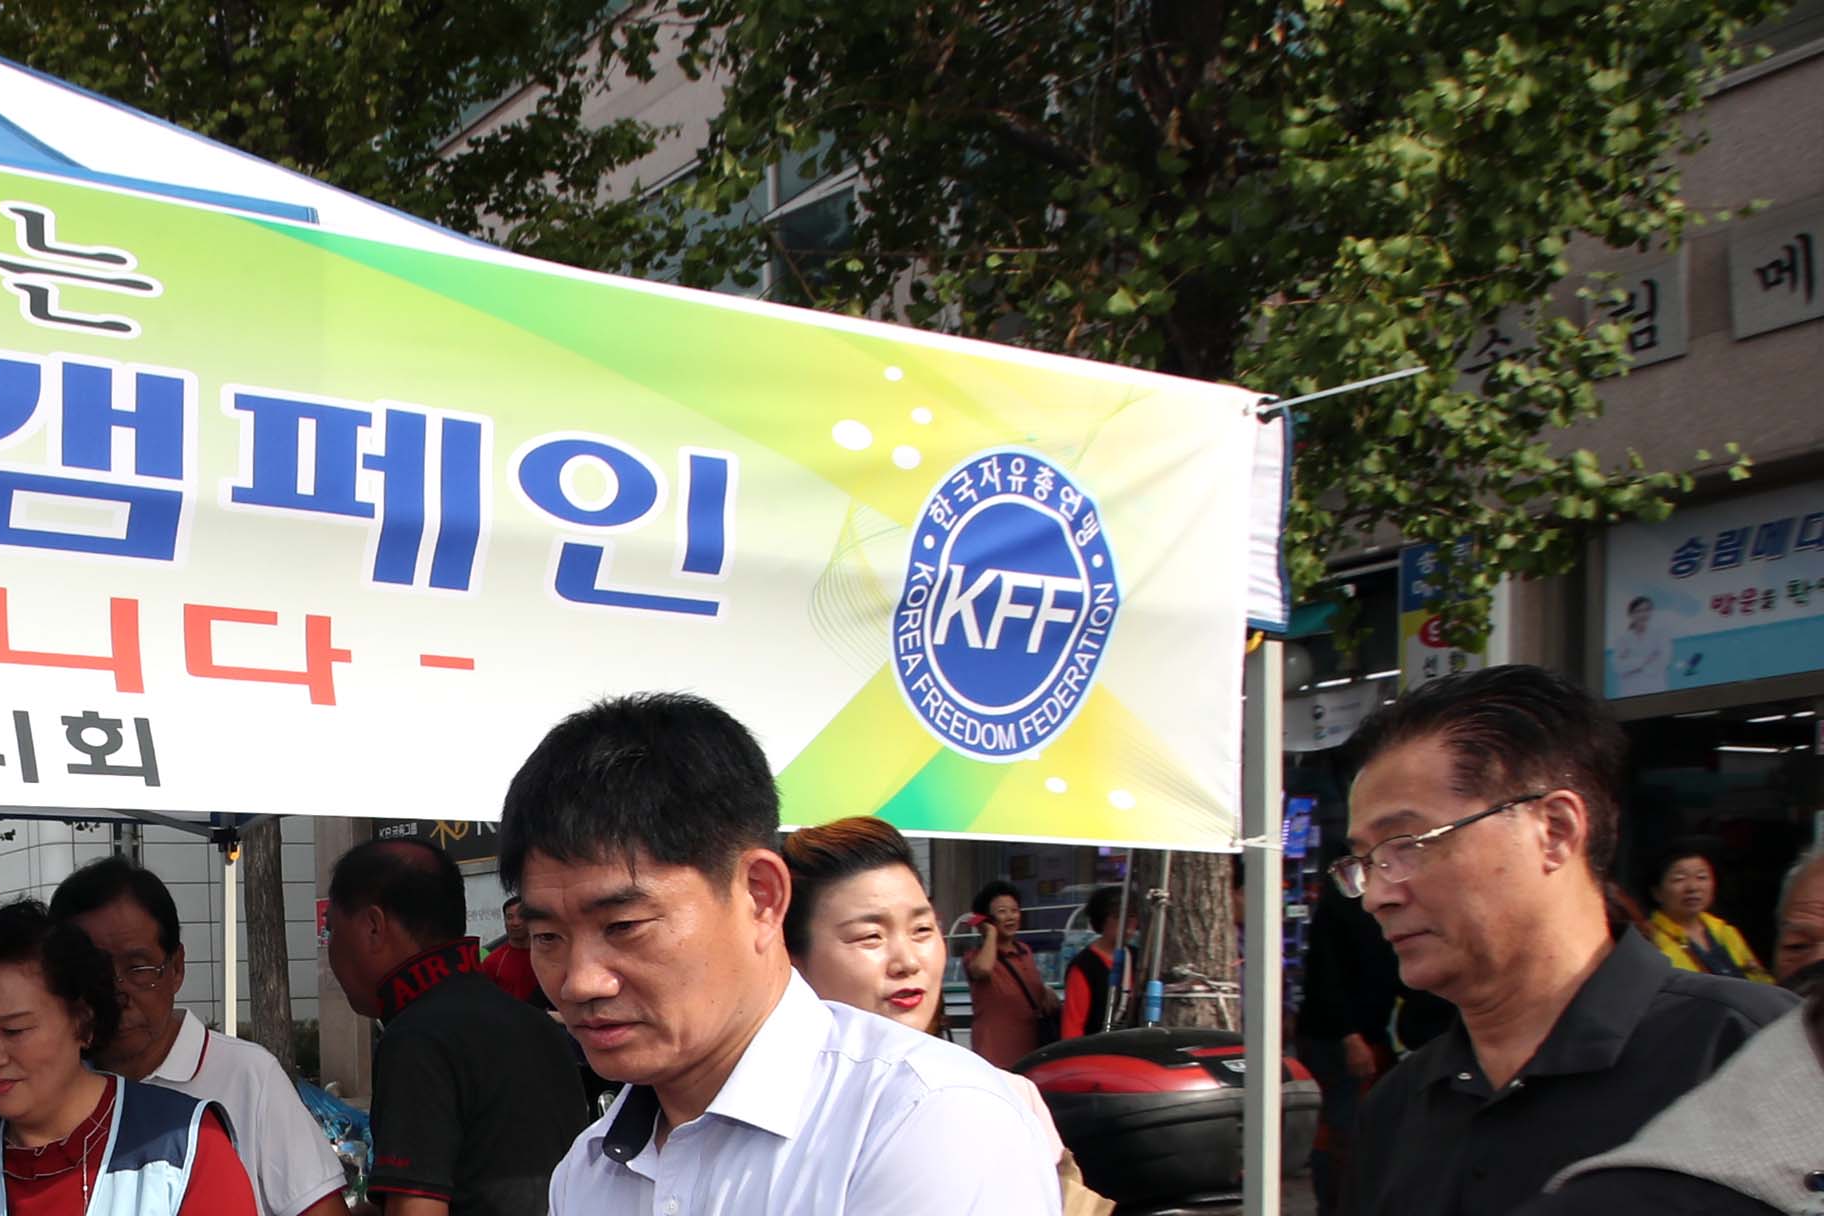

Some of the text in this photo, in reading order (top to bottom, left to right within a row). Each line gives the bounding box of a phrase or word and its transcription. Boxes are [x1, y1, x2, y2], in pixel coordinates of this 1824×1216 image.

[928, 456, 1100, 547] 한국자유총연맹
[933, 564, 1085, 654] KFF
[898, 561, 1115, 751] KOREA FREEDOM FEDERATION
[393, 956, 451, 1009] AIR
